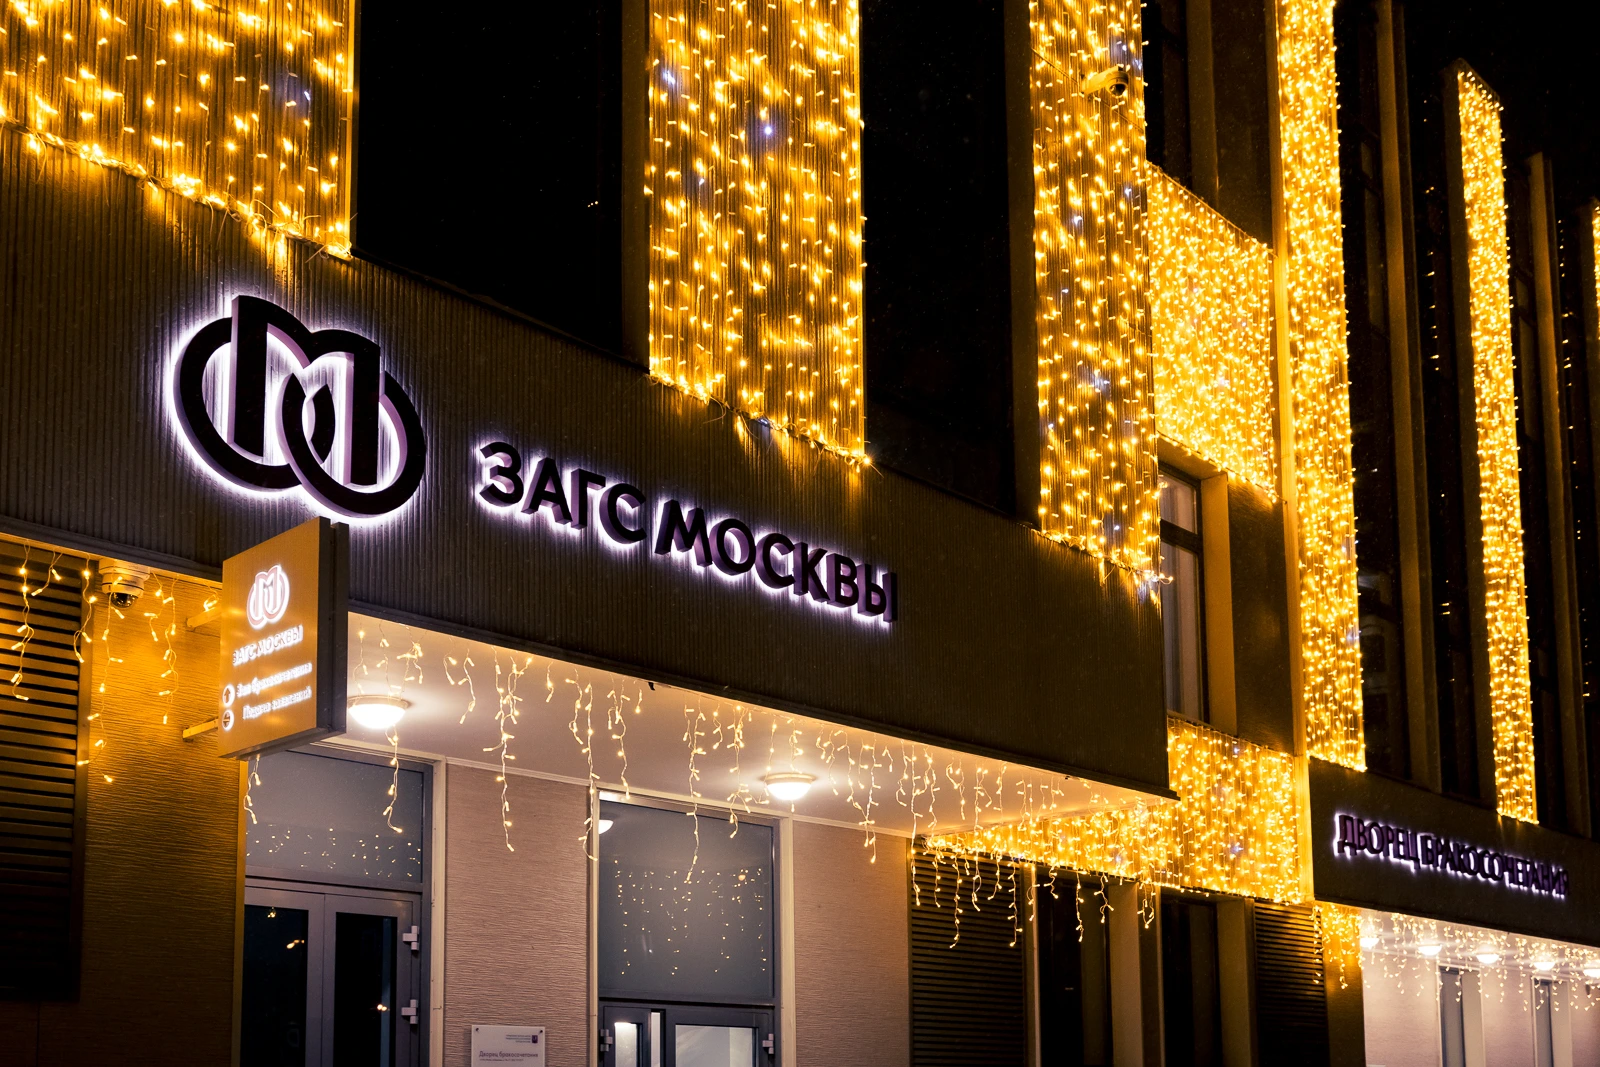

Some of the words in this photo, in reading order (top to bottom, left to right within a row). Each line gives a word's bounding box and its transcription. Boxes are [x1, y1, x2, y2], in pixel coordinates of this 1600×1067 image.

[478, 441, 647, 544] ЗАГС
[654, 500, 898, 623] МОСКВЫ
[233, 643, 257, 667] ЗАГС
[257, 624, 303, 657] МОСКВЫ
[1336, 814, 1420, 870] ДВОРЕЦ
[1420, 834, 1569, 896] БРАКОСОЧЕТАНИЯ
